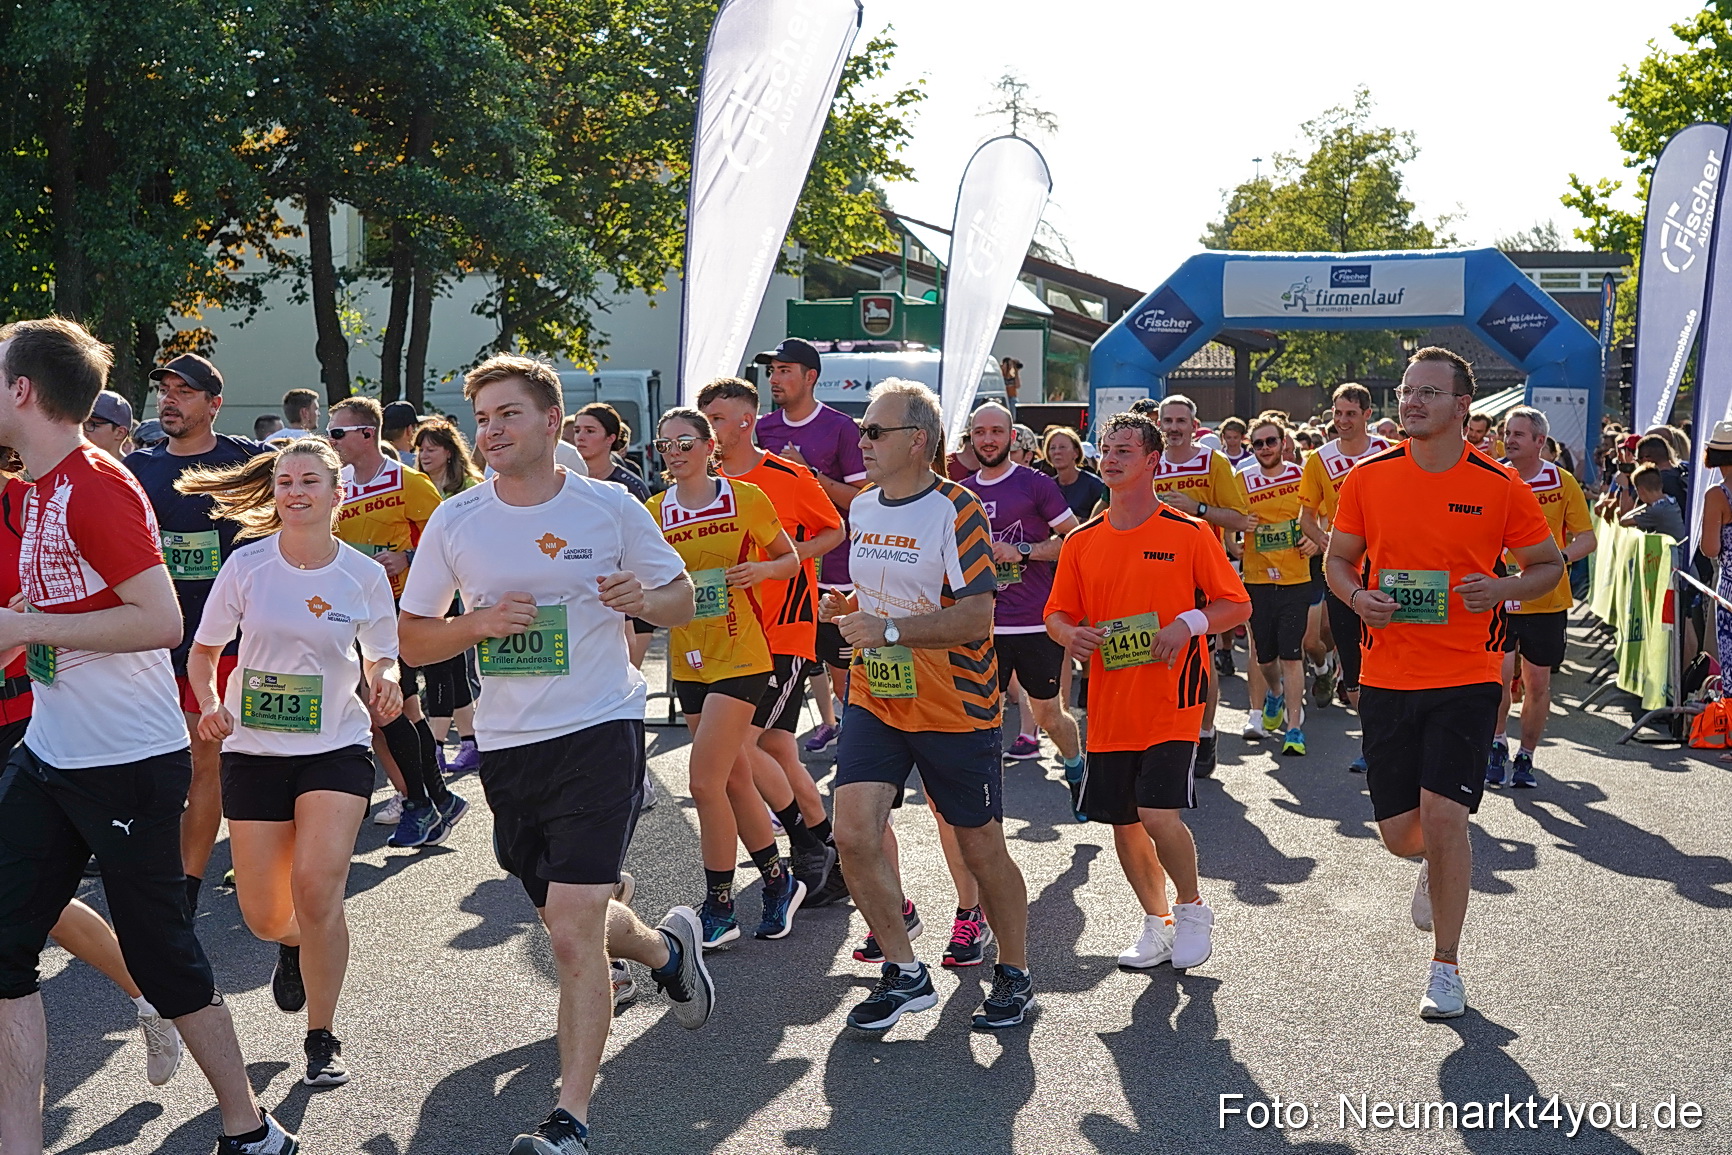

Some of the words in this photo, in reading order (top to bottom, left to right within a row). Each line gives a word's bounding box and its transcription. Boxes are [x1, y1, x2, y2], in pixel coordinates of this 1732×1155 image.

[1674, 149, 1721, 254] Fischer
[1316, 287, 1405, 305] firmenlauf
[1143, 316, 1193, 328] Fischer
[817, 379, 840, 389] vent
[1177, 477, 1210, 489] BÖGL
[1249, 491, 1276, 504] MAX
[1279, 484, 1300, 497] BÖG
[1538, 492, 1563, 505] ÖGL
[364, 495, 406, 513] BÖGL
[1448, 503, 1483, 515] THULE
[697, 522, 740, 538] BÖGL
[1260, 532, 1287, 543] 1643
[861, 532, 921, 551] KLEBL
[171, 548, 204, 565] 879
[210, 549, 219, 572] 2022
[857, 546, 919, 564] DYNAMICS
[1143, 551, 1176, 562] THULE
[718, 586, 726, 610] 2022
[1390, 587, 1436, 607] 1394
[327, 615, 352, 623] NEUMARKT
[482, 639, 490, 663] RUN
[497, 630, 544, 654] 200
[554, 633, 564, 666] 2022
[1109, 631, 1151, 653] 1410
[491, 656, 515, 664] Triller
[515, 655, 553, 664] Andreas
[1132, 649, 1151, 658] Denny
[866, 659, 901, 681] 1081
[903, 665, 913, 691] 2022
[877, 681, 902, 689] Michael
[244, 695, 253, 717] RUN
[259, 692, 301, 714] 213
[309, 698, 318, 726] 2022
[252, 711, 277, 720] Schmidt
[277, 714, 310, 722] Franziska
